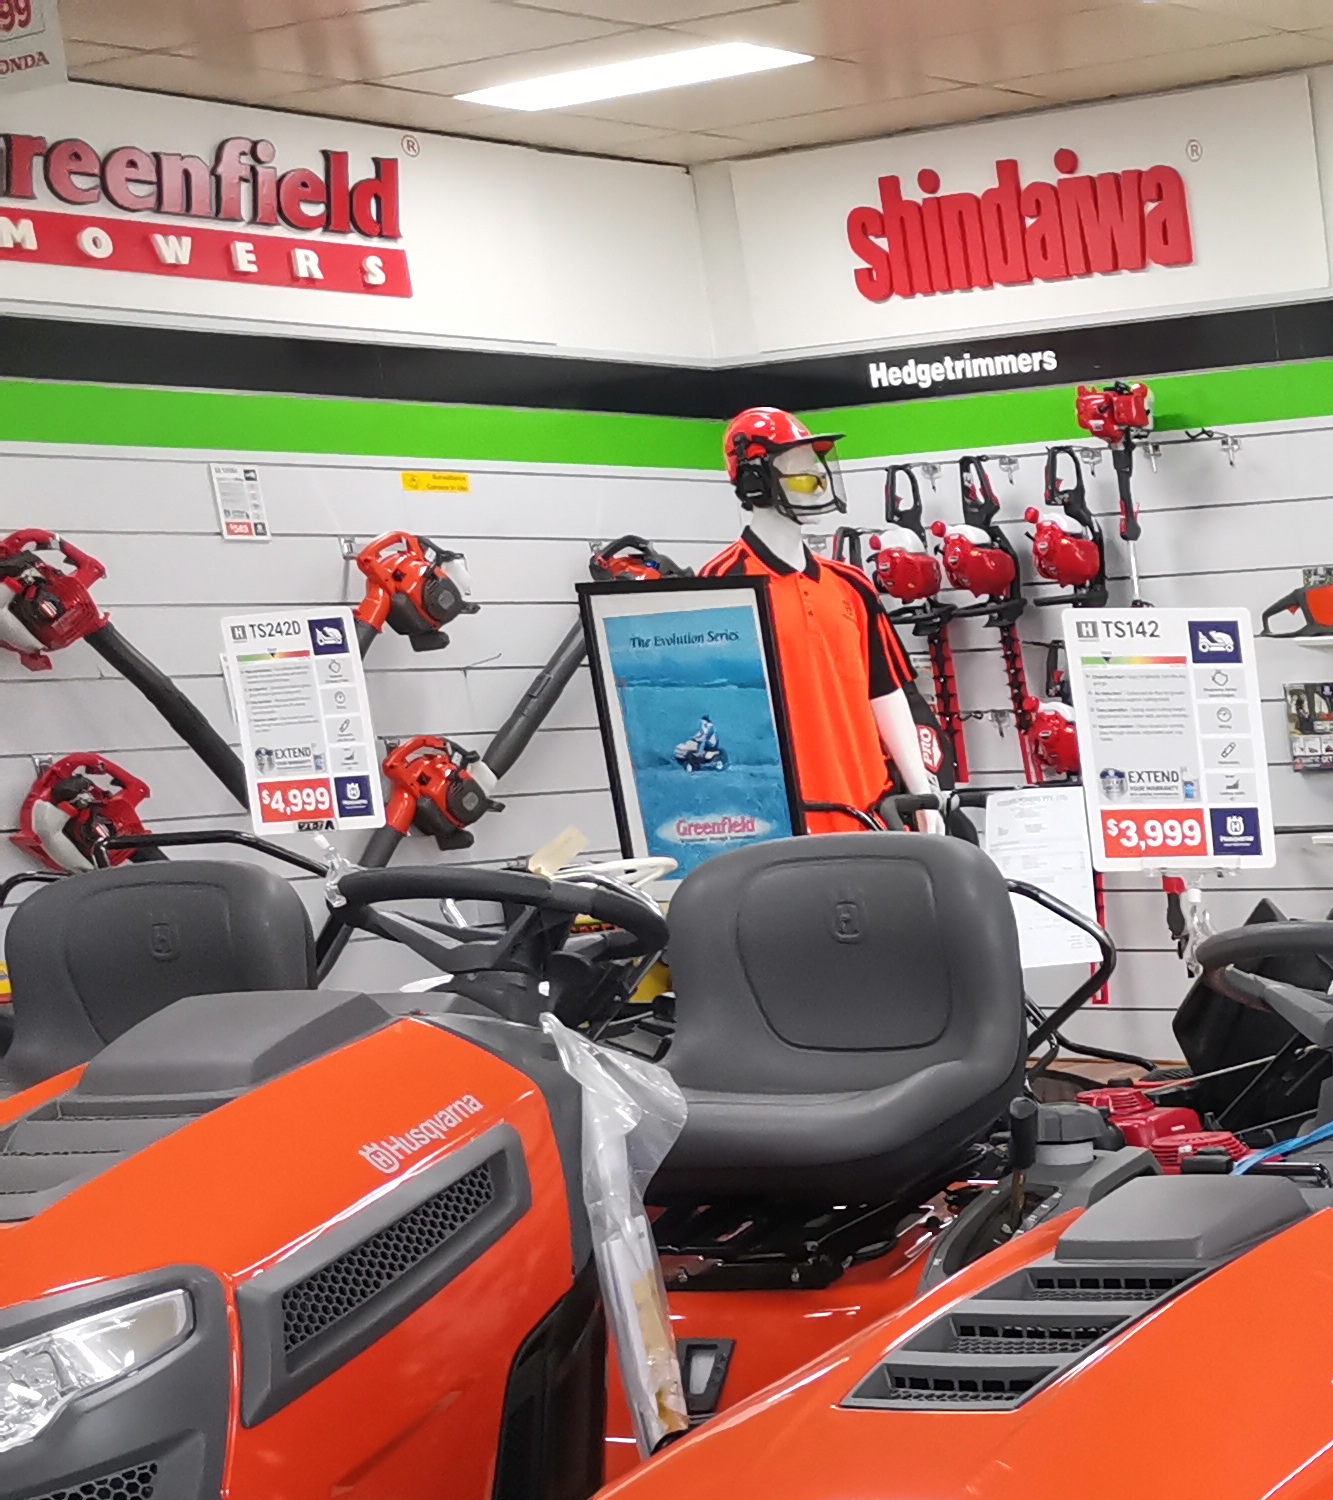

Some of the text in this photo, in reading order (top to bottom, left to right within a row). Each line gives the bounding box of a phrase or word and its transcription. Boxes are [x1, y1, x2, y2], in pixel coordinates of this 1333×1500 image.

[0, 51, 50, 75] ONDA
[0, 133, 402, 240] reenfield
[847, 147, 1194, 303] shindaiwa
[0, 218, 387, 287] MOWERS
[869, 349, 1058, 390] Hedgetrimmers
[630, 629, 740, 649] The Evolution Series
[1101, 620, 1161, 638] TS142
[274, 747, 312, 760] EXTEND
[920, 727, 934, 766] PRO
[1128, 770, 1179, 783] EXTEND
[261, 786, 330, 815] $4,999
[676, 815, 756, 837] Greenfield
[1107, 818, 1202, 851] $3,999
[388, 1093, 484, 1160] Husqvarna
